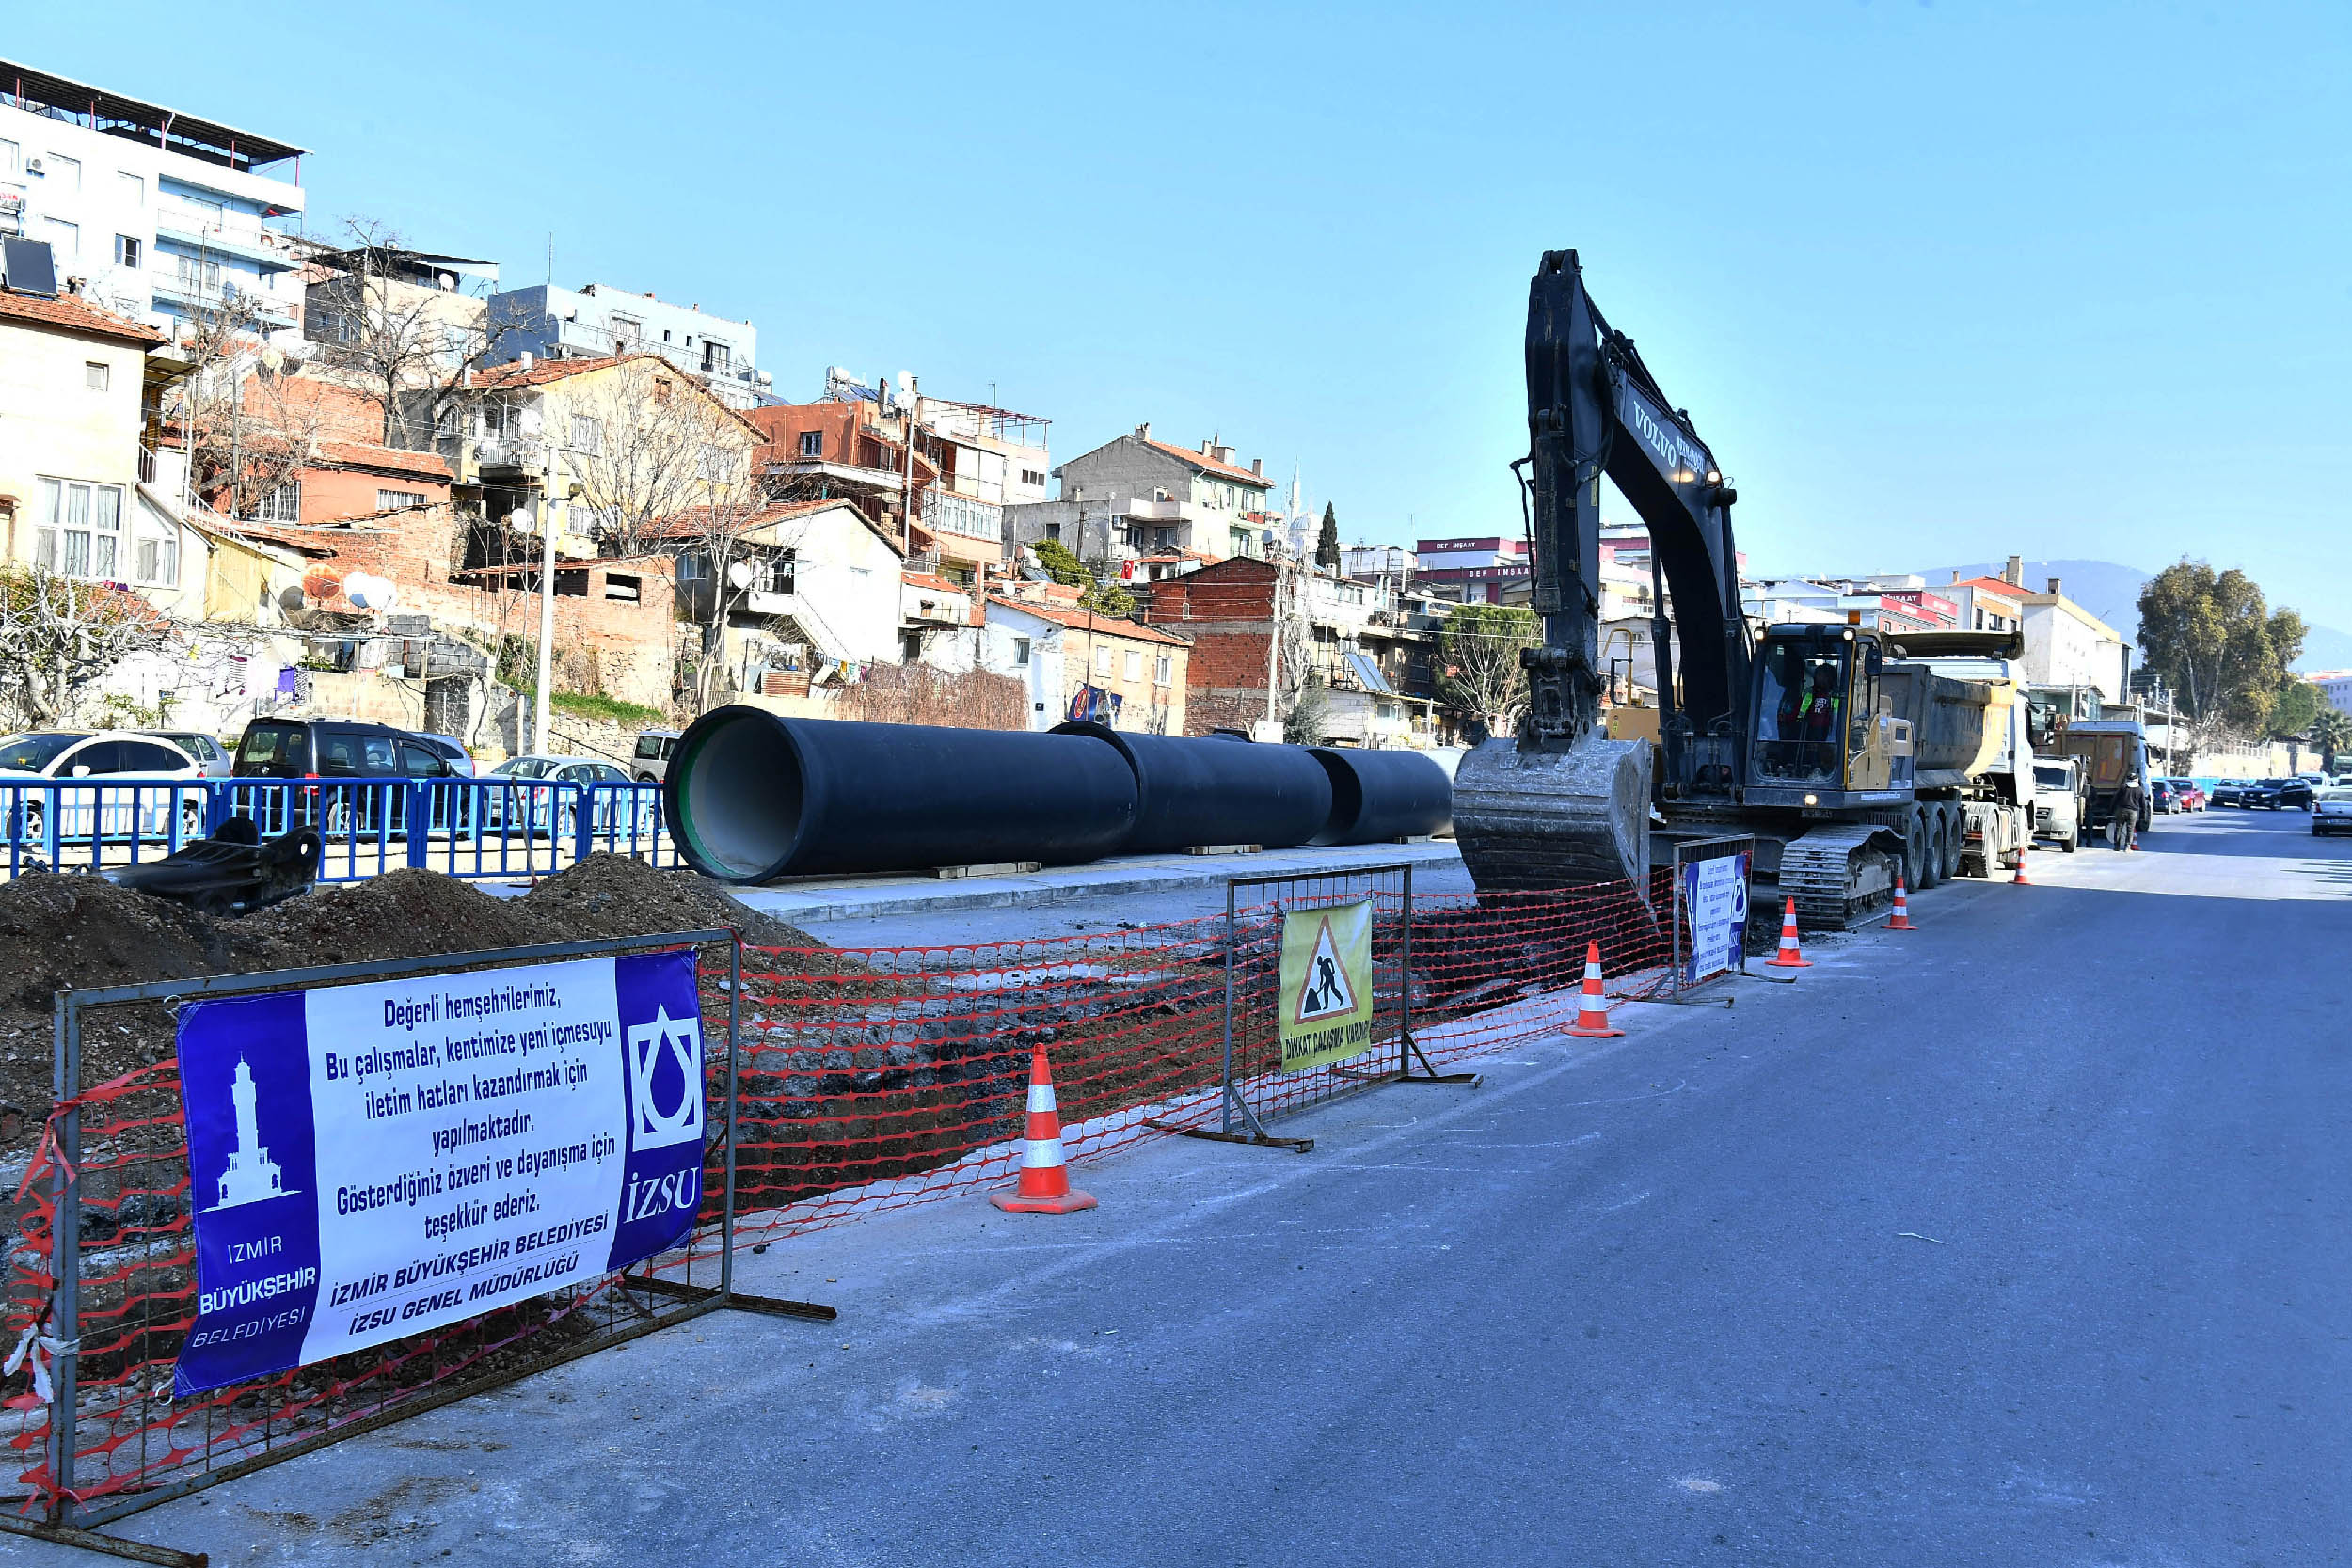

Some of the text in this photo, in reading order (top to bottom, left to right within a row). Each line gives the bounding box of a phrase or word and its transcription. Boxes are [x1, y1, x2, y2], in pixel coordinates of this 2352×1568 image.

[1633, 400, 1677, 467] VOLVO
[384, 983, 561, 1031] Değerli hemşehrilerimiz,
[326, 1019, 612, 1085] Bu çalışmalar, kentimize yeni içmesuyu
[1285, 1032, 1311, 1060] DİKKAT
[1312, 1026, 1344, 1058] ÇALIŞMA
[365, 1057, 588, 1120] iletim hatları kazandırmak için
[432, 1109, 534, 1157] yapılmaktadır.
[337, 1133, 615, 1216] Gösterdiğiniz özveri ve dayanışma için
[623, 1166, 700, 1224] İZSU
[424, 1187, 540, 1243] teşekkür ederiz.
[330, 1209, 610, 1307] İZMİR BÜYÜKŞEHİR BELEDİYESİ
[199, 1266, 316, 1315] BÜYÜKŞEHİR
[348, 1250, 580, 1336] İZSU GENEL MÜDÜRLÜĞÜ
